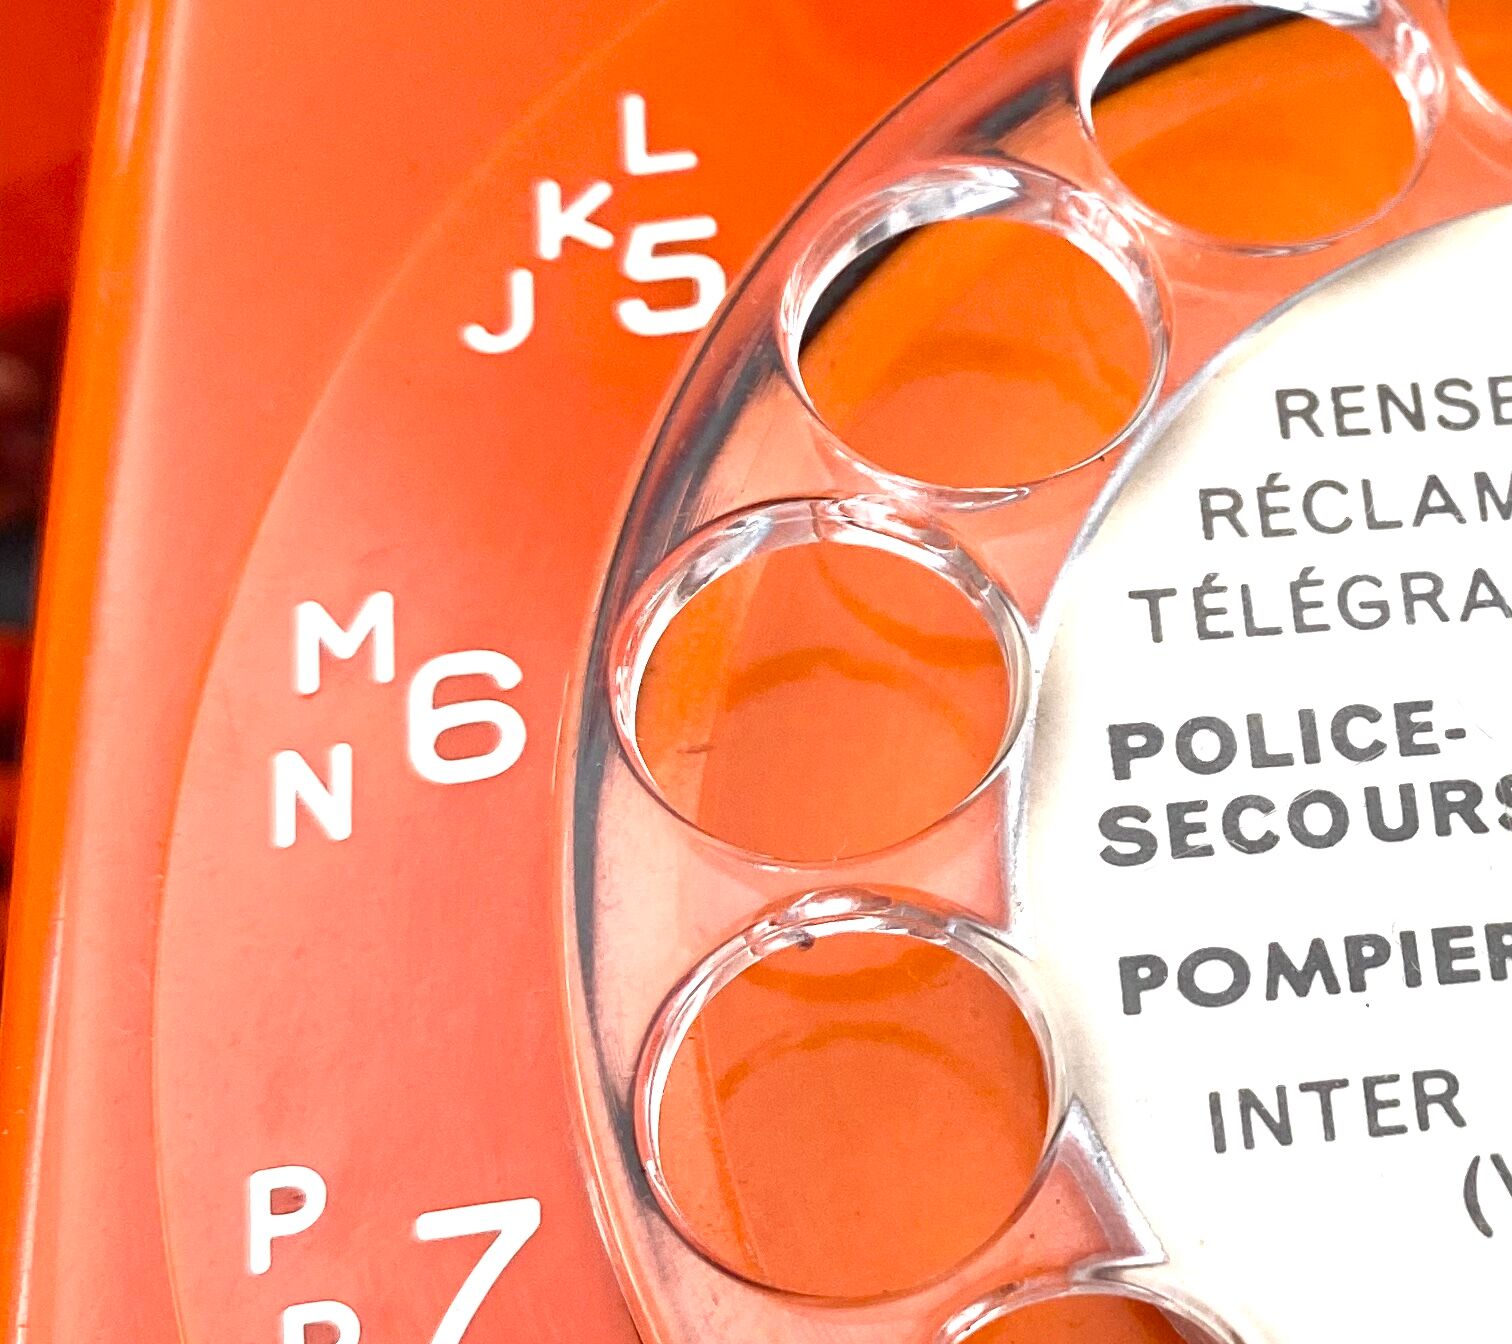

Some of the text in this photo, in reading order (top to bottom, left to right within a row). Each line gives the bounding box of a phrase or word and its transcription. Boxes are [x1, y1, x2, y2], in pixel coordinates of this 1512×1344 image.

[616, 214, 728, 337] 5
[403, 648, 528, 787] 6
[1106, 698, 1468, 782] POLICE-
[1207, 1068, 1468, 1155] INTER
